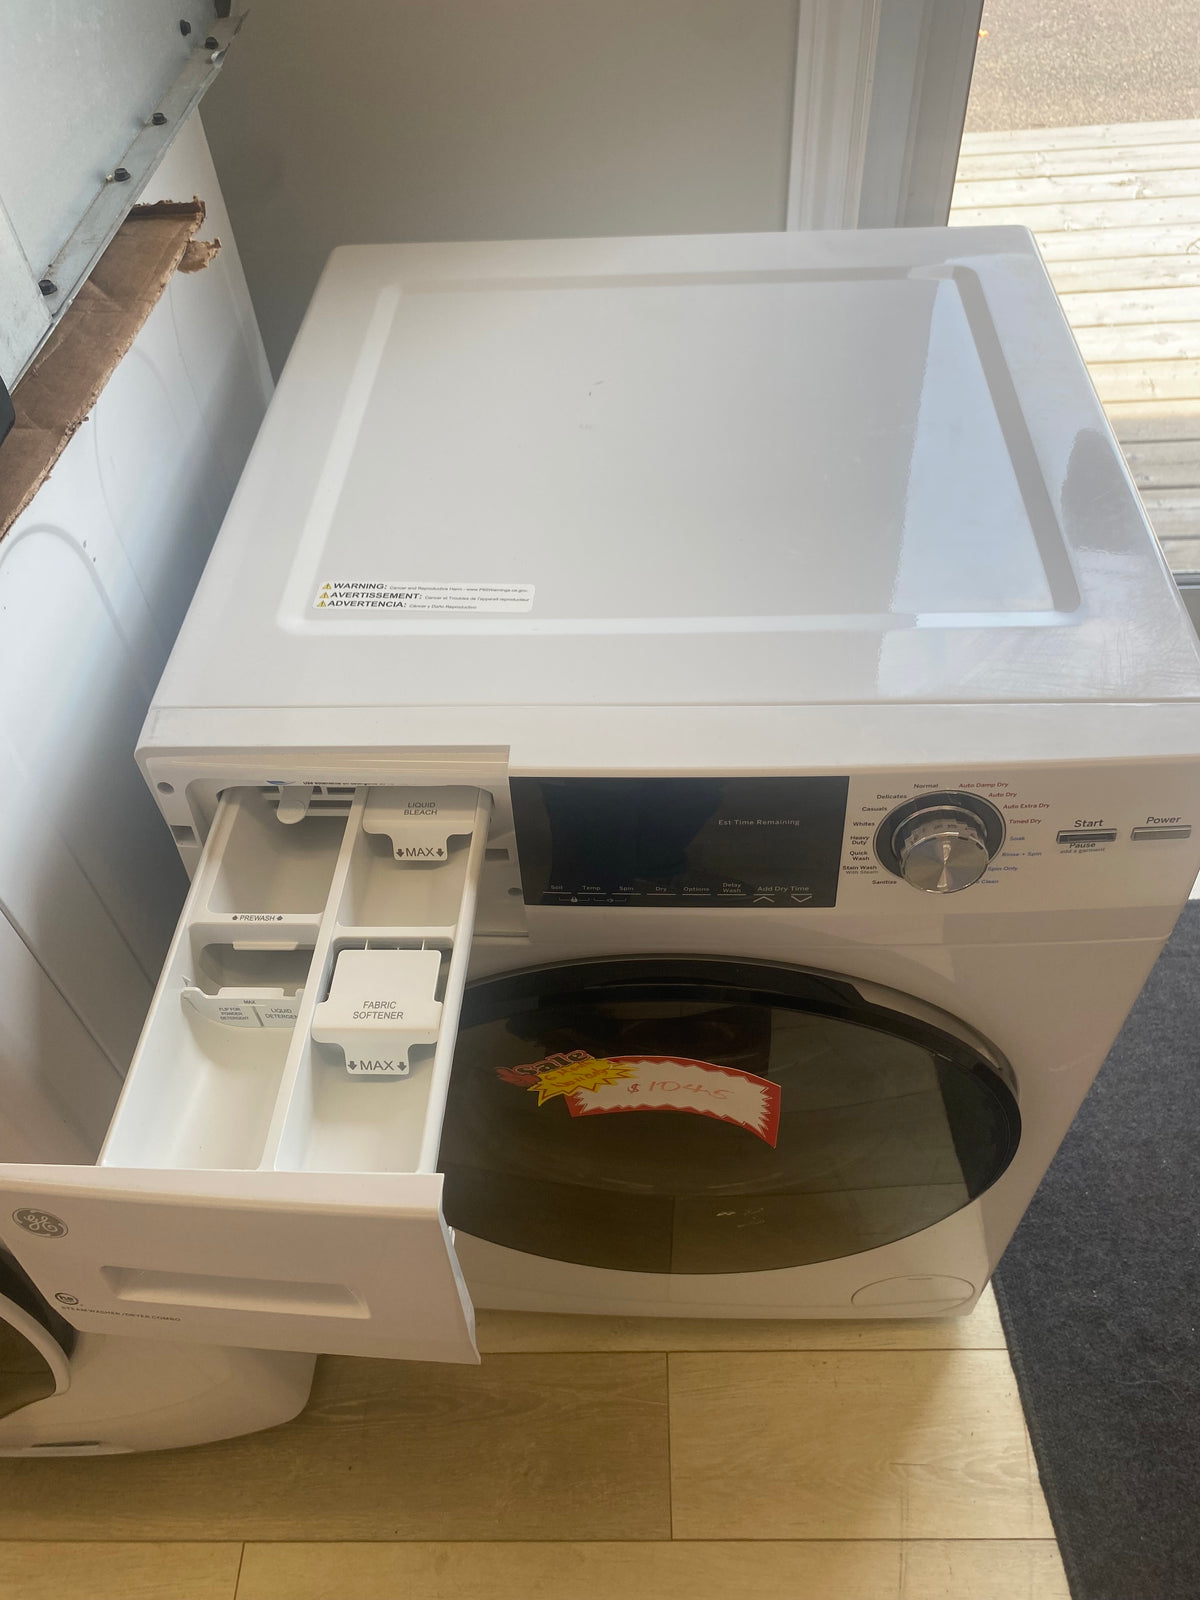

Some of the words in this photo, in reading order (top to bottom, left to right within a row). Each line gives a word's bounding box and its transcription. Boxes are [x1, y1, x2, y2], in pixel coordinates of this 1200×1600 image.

[333, 582, 388, 590] WARNING:
[330, 591, 423, 600] AVERTISSEMENT:
[327, 600, 407, 608] ADVERTENCIA:
[407, 801, 436, 809] LIQUID
[1074, 819, 1104, 828] Start
[1145, 816, 1182, 825] Power
[405, 847, 435, 857] MAX
[239, 914, 276, 922] PREWASH
[362, 1000, 397, 1009] FABRIC
[352, 1011, 404, 1020] SOFTENER
[359, 1060, 395, 1071] MAX
